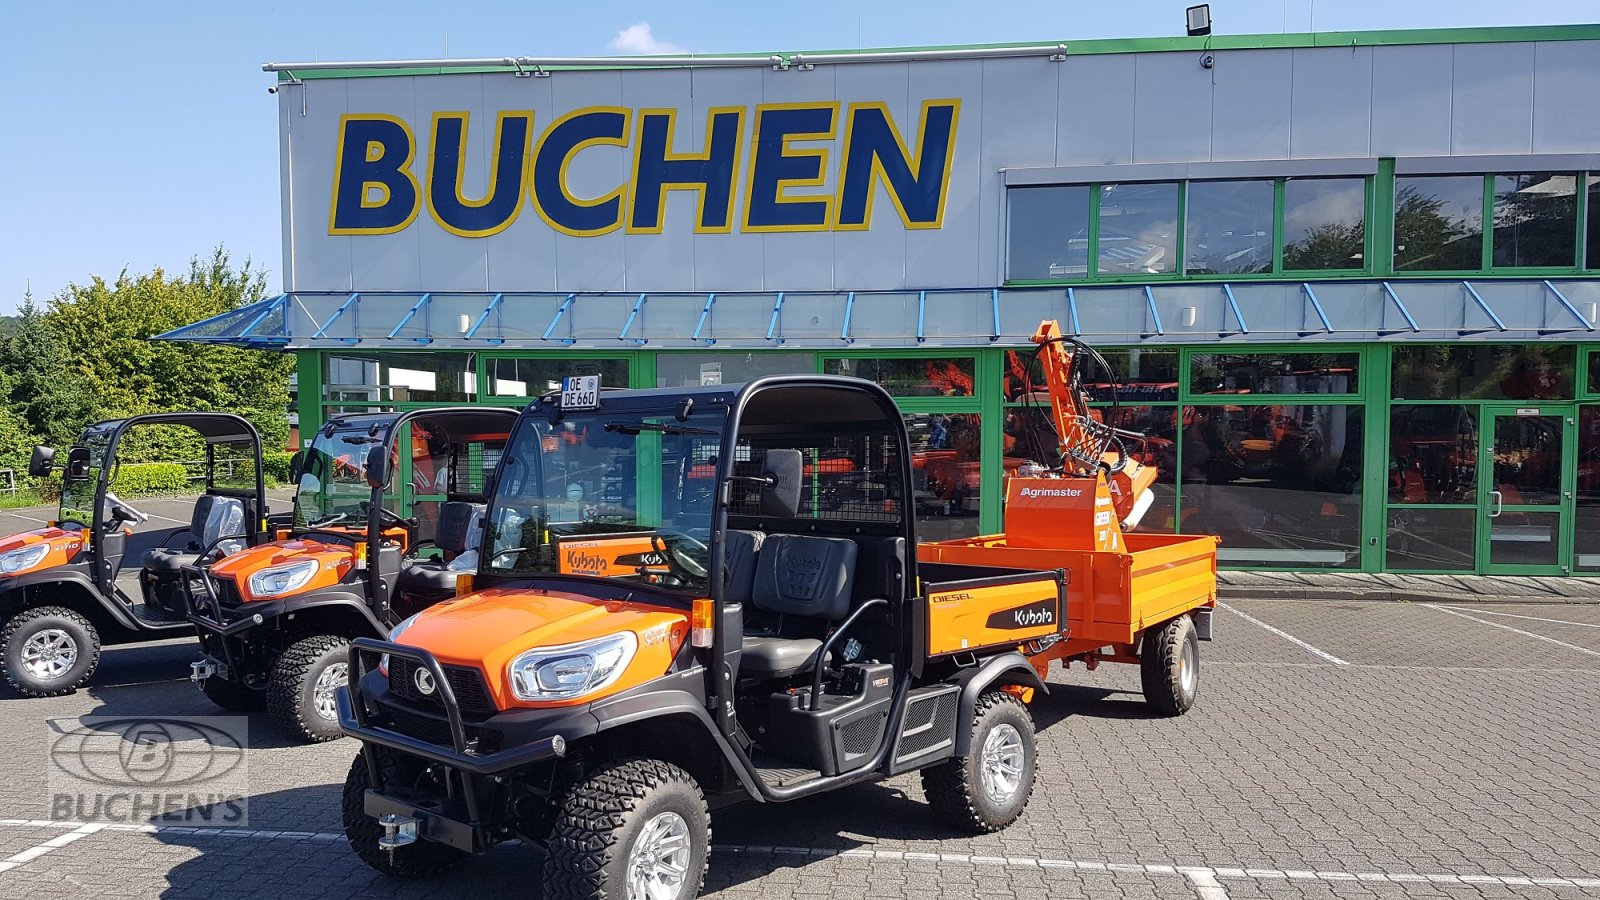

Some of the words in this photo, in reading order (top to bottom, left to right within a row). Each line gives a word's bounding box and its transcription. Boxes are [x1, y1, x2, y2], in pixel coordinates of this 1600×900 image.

[328, 98, 962, 238] BUCHEN
[570, 378, 582, 391] OE
[564, 393, 576, 406] DE
[577, 391, 594, 405] 660
[1020, 487, 1083, 498] Agrimaster
[567, 551, 607, 570] Kubota
[641, 553, 663, 565] Kub
[932, 593, 974, 603] DIESEL
[1014, 607, 1053, 625] Kubota
